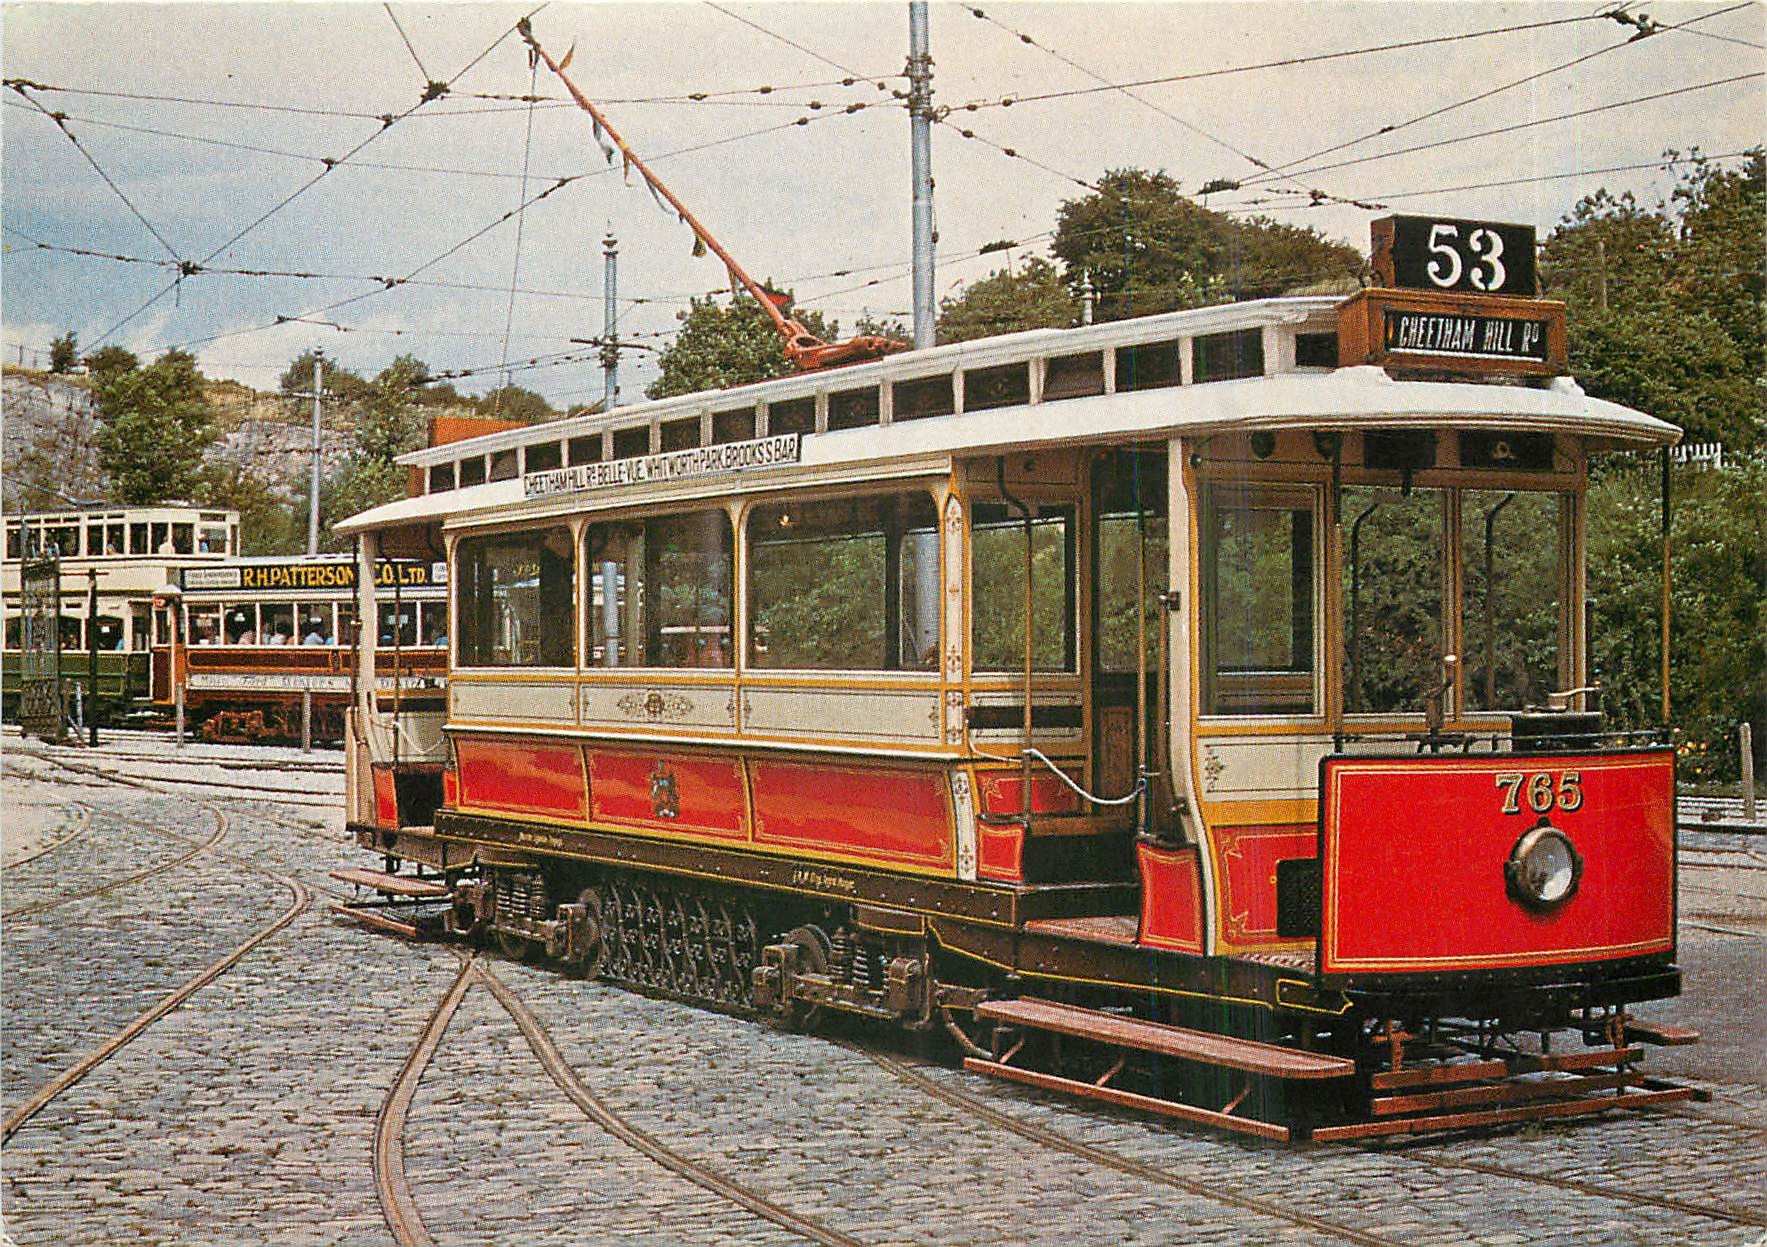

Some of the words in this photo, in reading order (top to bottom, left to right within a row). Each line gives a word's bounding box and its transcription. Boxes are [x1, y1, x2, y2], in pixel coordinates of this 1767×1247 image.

[1427, 223, 1507, 291] 53
[1399, 315, 1476, 350] CHEETHAM
[1482, 320, 1513, 352] HILL
[523, 470, 567, 496] CHEETHAM
[568, 467, 586, 490] HILL
[646, 452, 699, 479] WHITWORTH
[700, 448, 725, 474] PARK
[1495, 771, 1584, 815] 765
